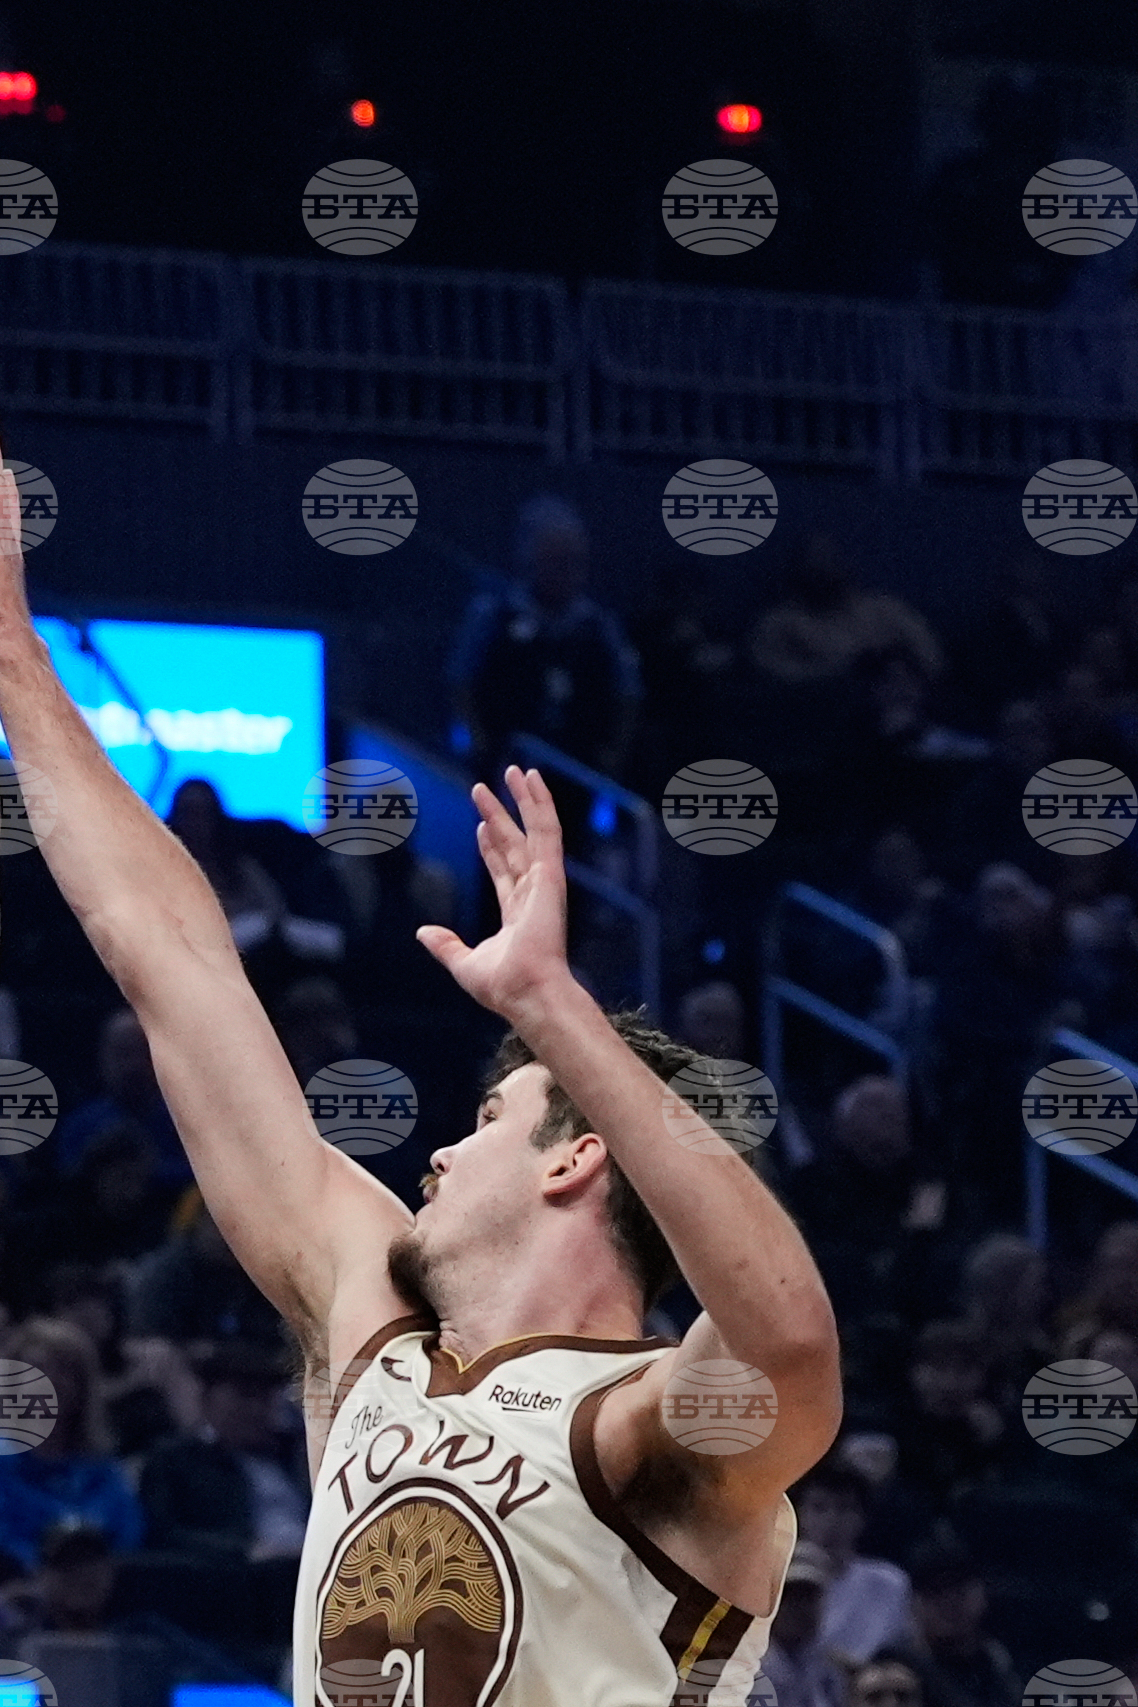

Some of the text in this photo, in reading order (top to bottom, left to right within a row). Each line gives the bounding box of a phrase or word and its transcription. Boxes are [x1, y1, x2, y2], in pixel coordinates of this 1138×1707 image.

[488, 1384, 562, 1413] Rakuten
[345, 1404, 384, 1449] The
[328, 1419, 551, 1521] TOWN
